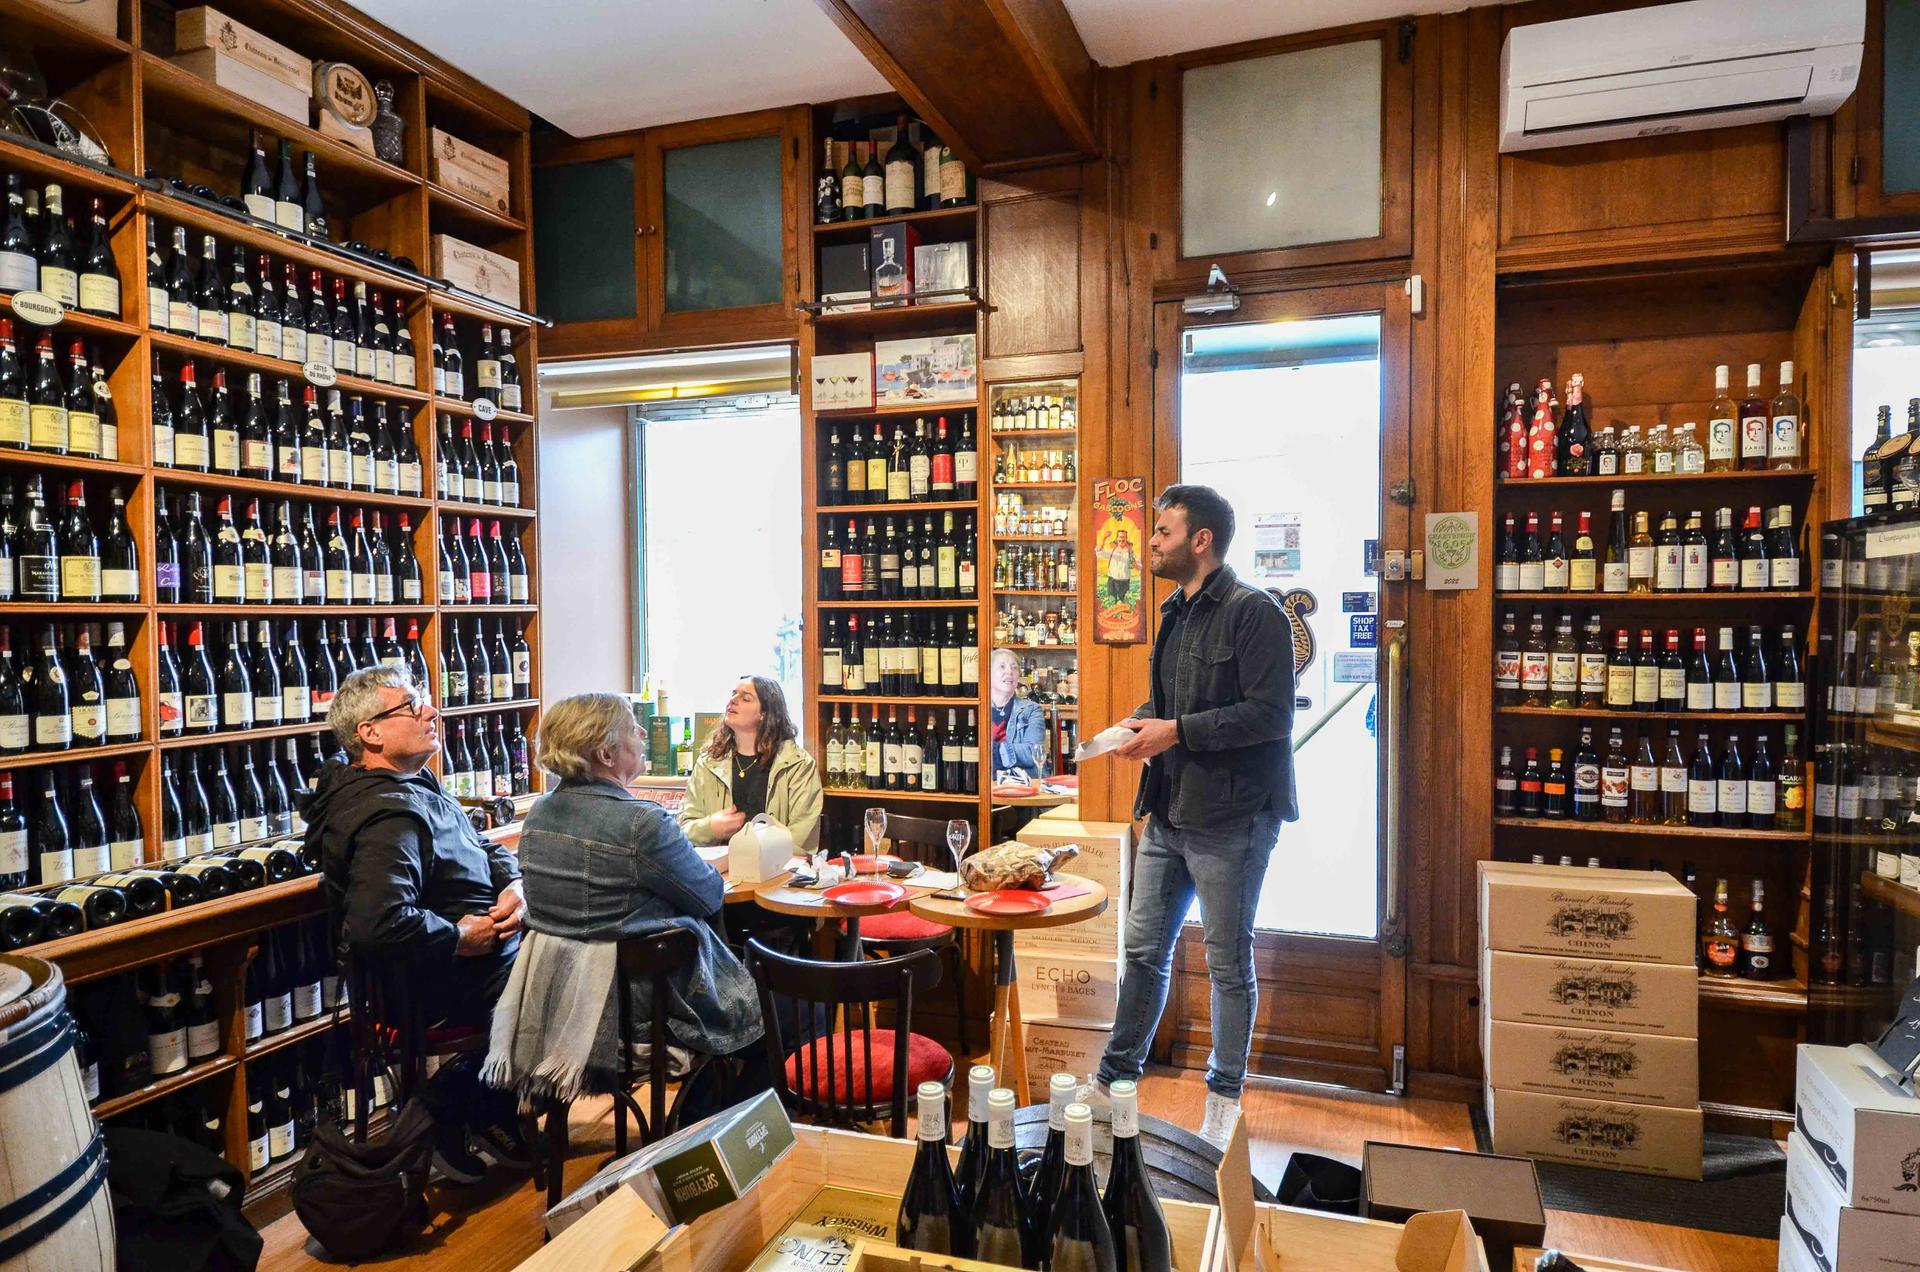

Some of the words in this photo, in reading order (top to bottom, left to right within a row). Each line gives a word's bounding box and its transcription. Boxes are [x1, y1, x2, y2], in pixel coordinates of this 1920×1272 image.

[20, 301, 57, 315] BOURGOGNE
[478, 404, 491, 414] CAVE
[1094, 478, 1142, 502] FLOC
[1093, 500, 1144, 512] GASCOGNE
[1352, 616, 1374, 625] SHOP
[1352, 624, 1369, 632] TAX
[1352, 631, 1373, 640] FREE
[1567, 940, 1611, 949] CHINON
[1036, 966, 1091, 984] ECHO
[1031, 983, 1058, 993] LYNCH
[1571, 1007, 1614, 1018] CHINON
[1025, 1046, 1086, 1058] AUT-MARBUZET
[1571, 1078, 1614, 1088] CHINON
[1574, 1147, 1617, 1159] CHINON
[674, 1172, 719, 1203] SPEYBURN
[812, 1216, 888, 1238] WHISKEY
[776, 1237, 850, 1266] ELING
